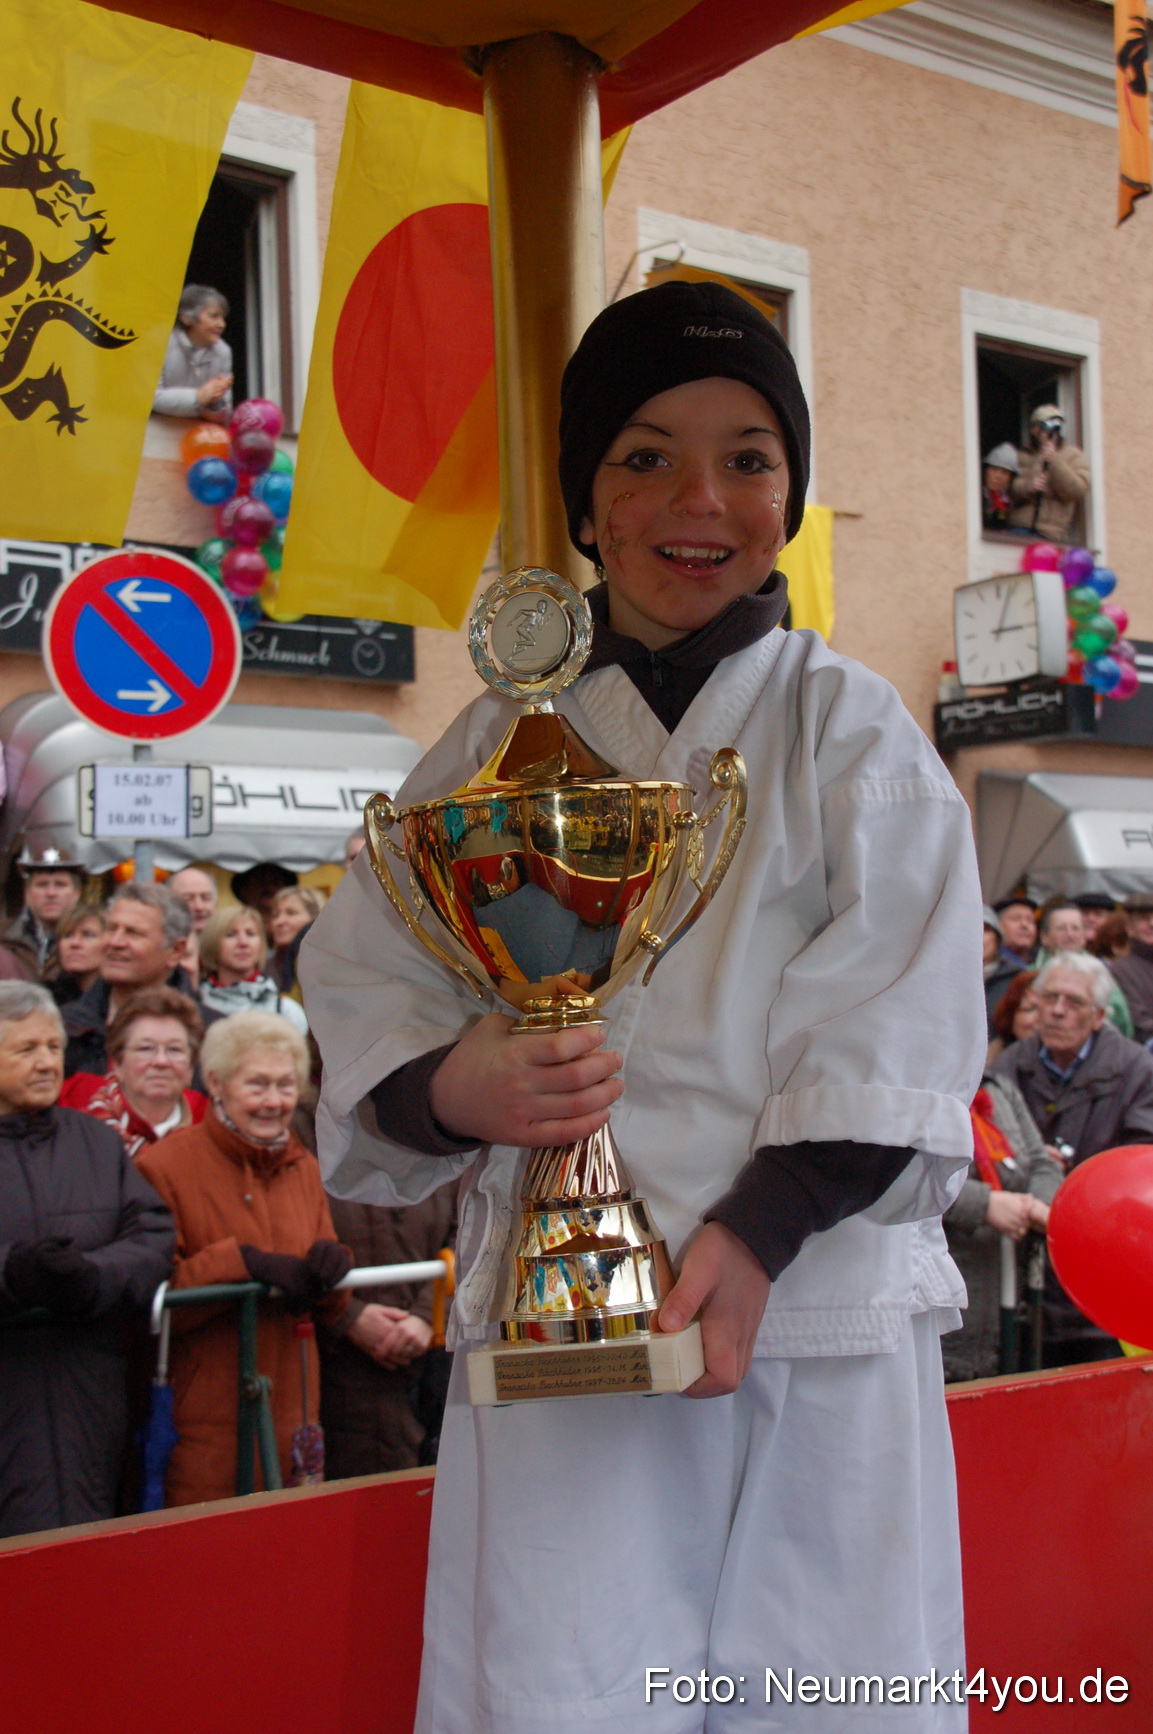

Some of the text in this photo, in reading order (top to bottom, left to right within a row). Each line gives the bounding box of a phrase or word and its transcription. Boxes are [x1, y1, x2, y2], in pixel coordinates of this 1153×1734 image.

[113, 773, 173, 788] 15.02.07
[133, 792, 153, 807] ab
[107, 811, 178, 826] 10.00 Uhr
